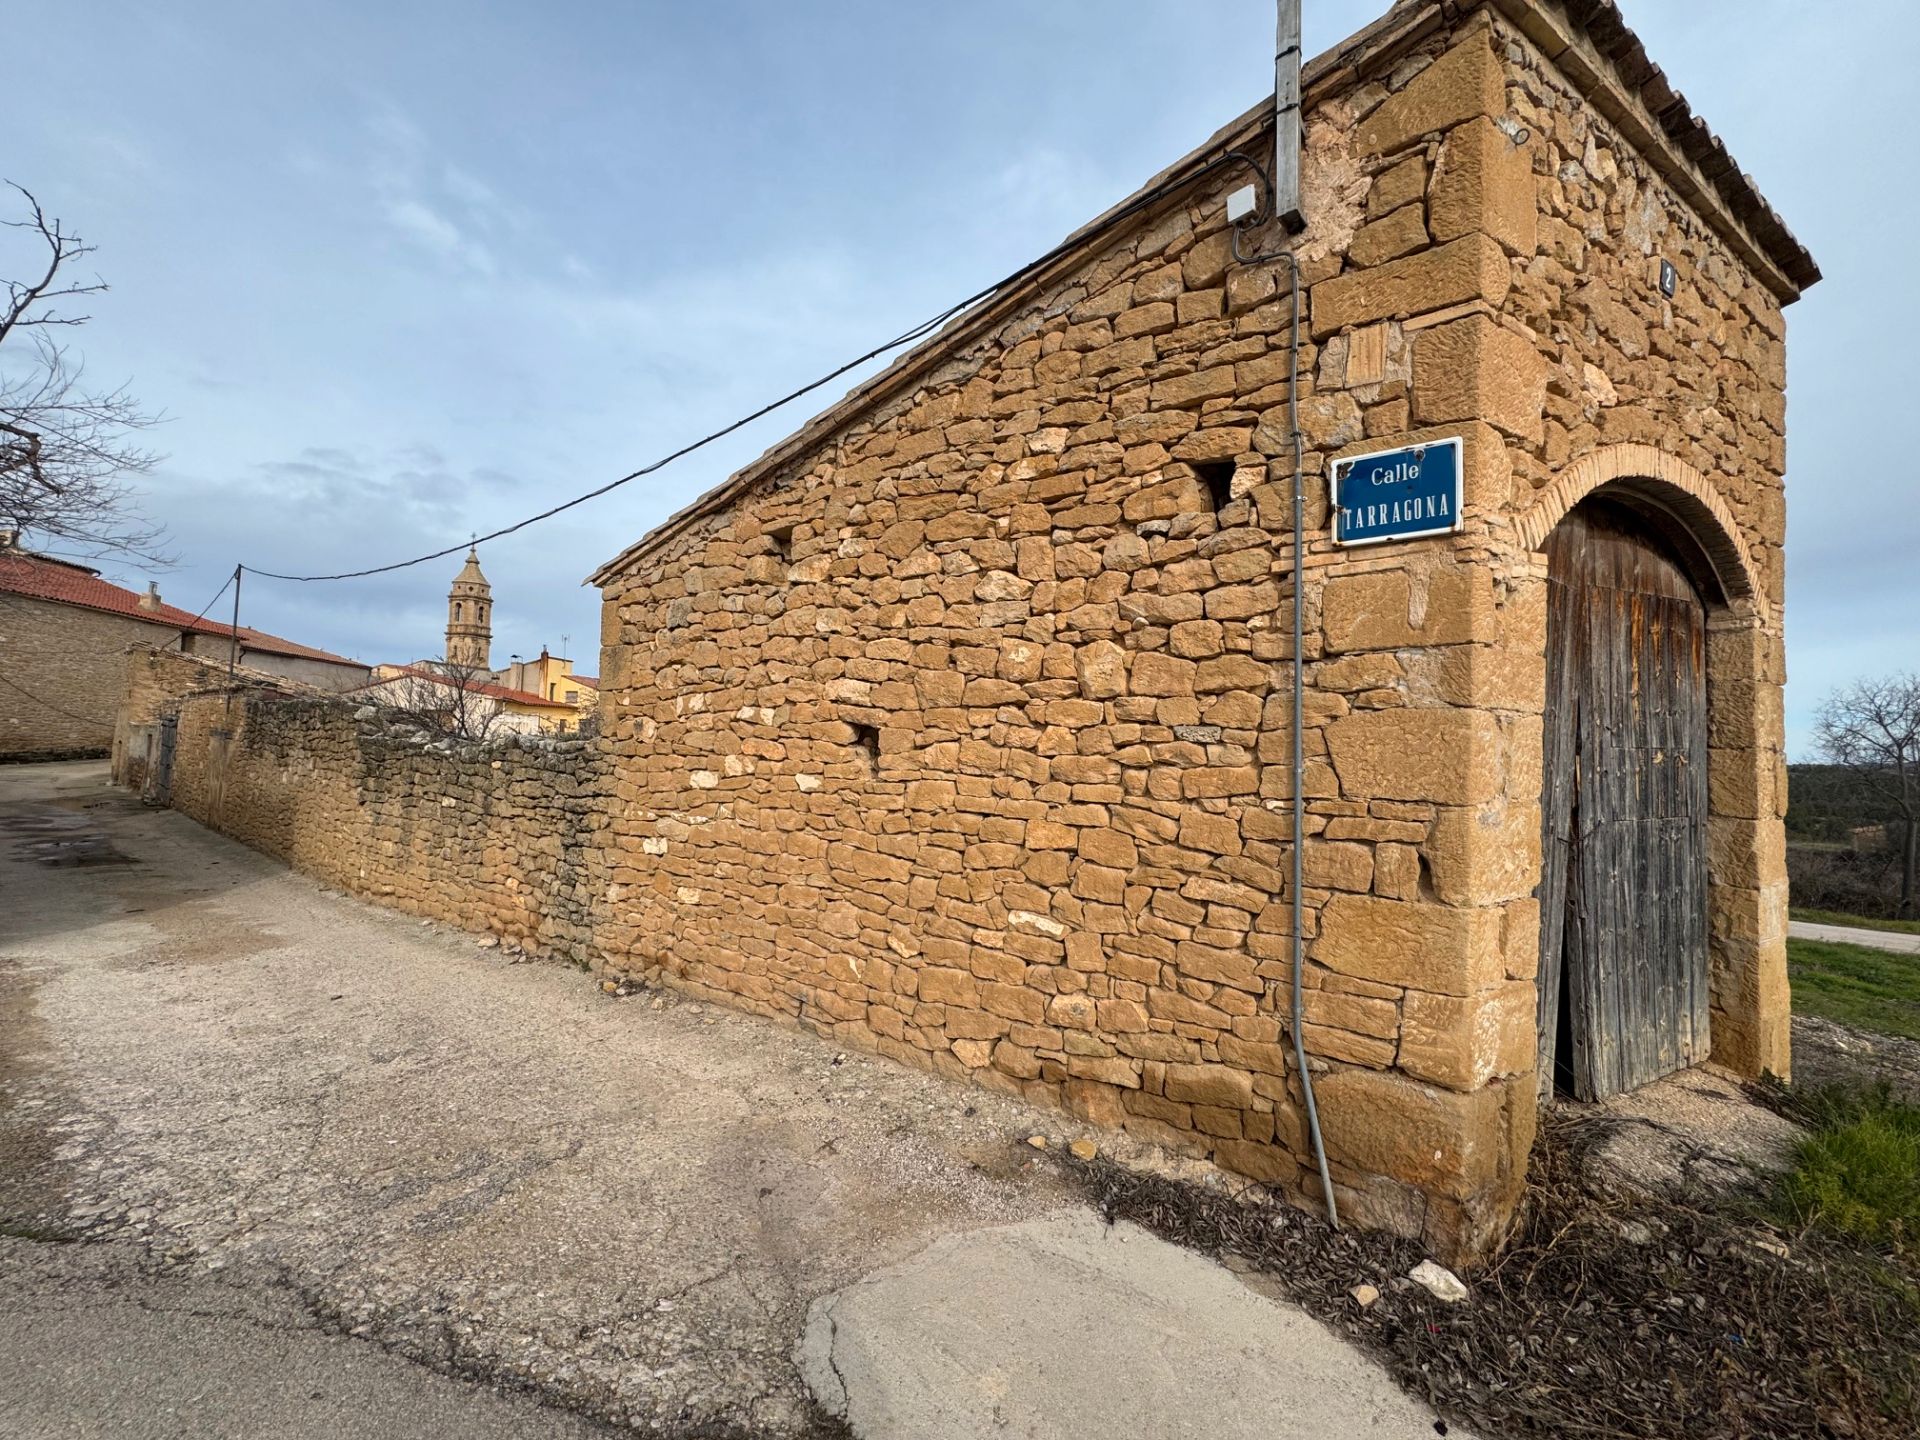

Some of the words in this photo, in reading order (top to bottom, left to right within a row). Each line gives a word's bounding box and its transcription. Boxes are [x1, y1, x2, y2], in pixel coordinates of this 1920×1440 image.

[1665, 266, 1672, 288] 2
[1371, 462, 1420, 486] Calle
[1343, 493, 1449, 530] TARRAGONA
